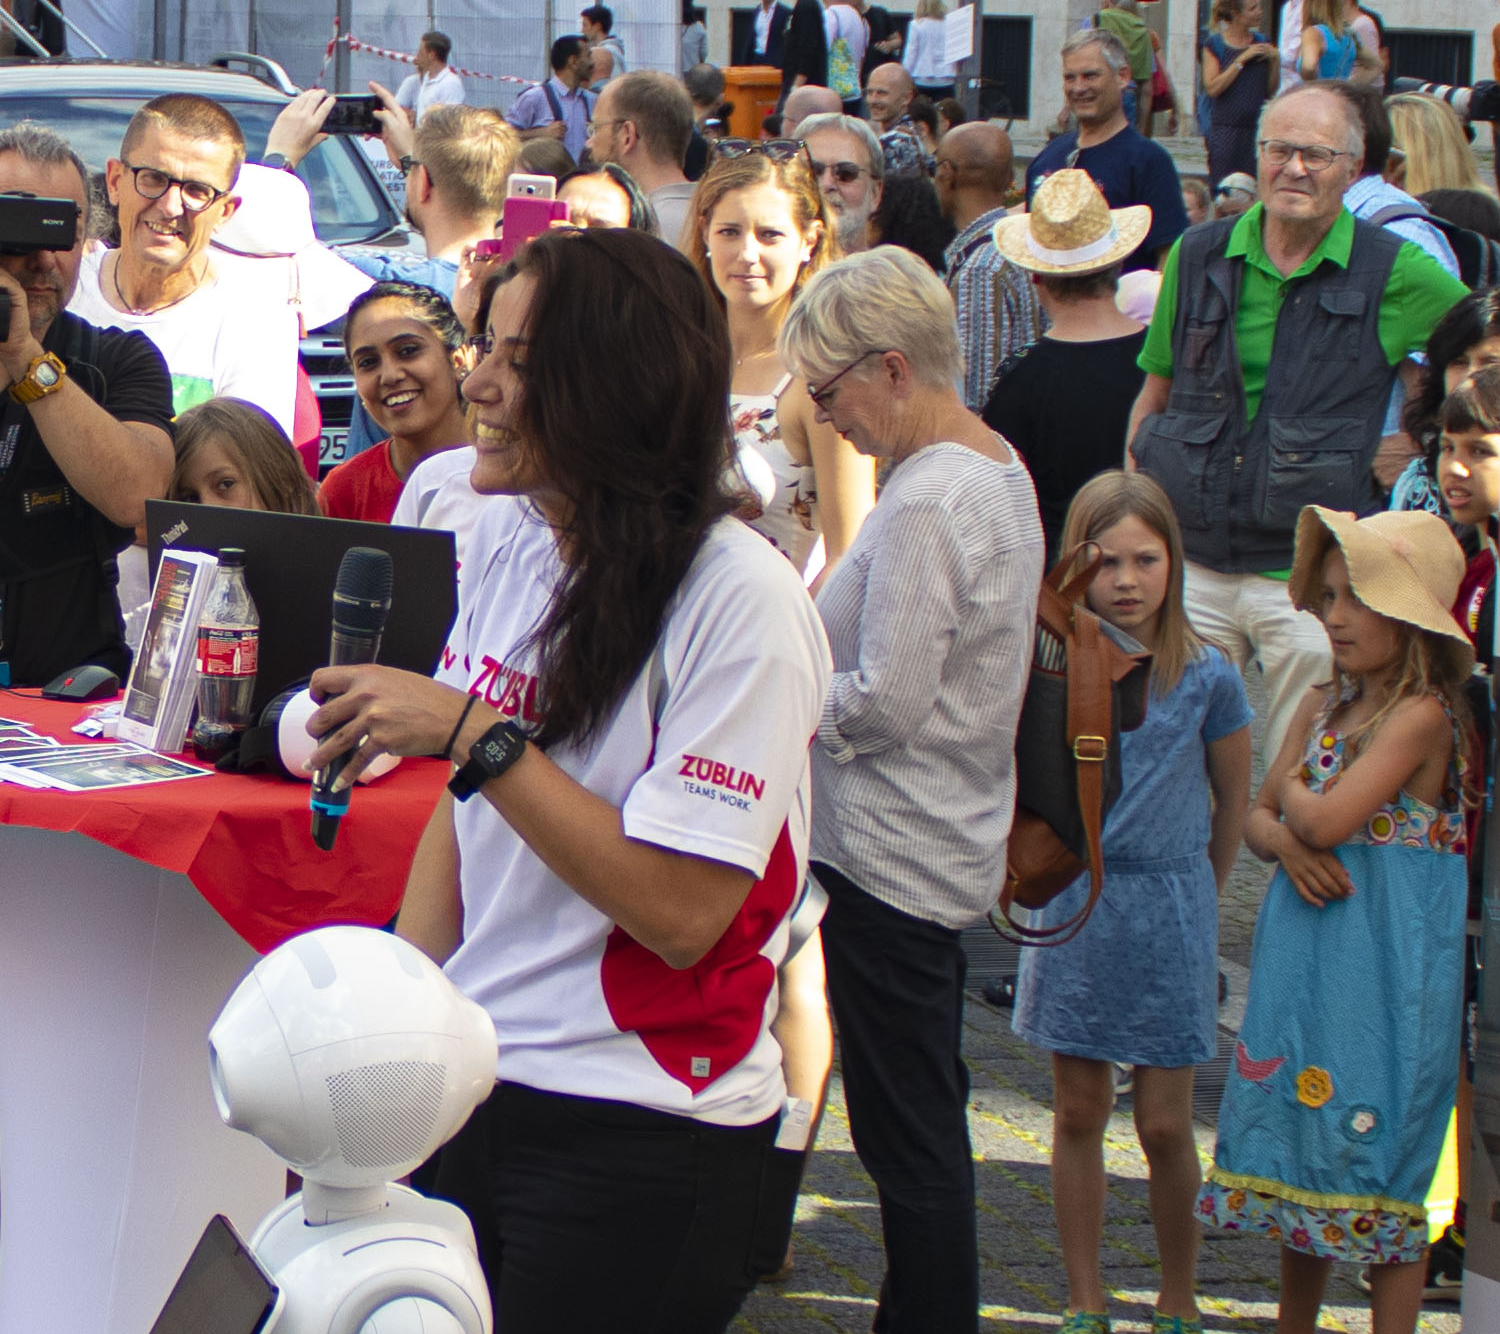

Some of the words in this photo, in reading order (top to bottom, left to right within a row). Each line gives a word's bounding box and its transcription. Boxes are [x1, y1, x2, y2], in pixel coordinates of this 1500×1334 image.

[42, 218, 65, 226] SONY
[678, 754, 766, 801] ZÜBLIN
[683, 781, 717, 800] TEAMS
[719, 792, 752, 813] WORK.
